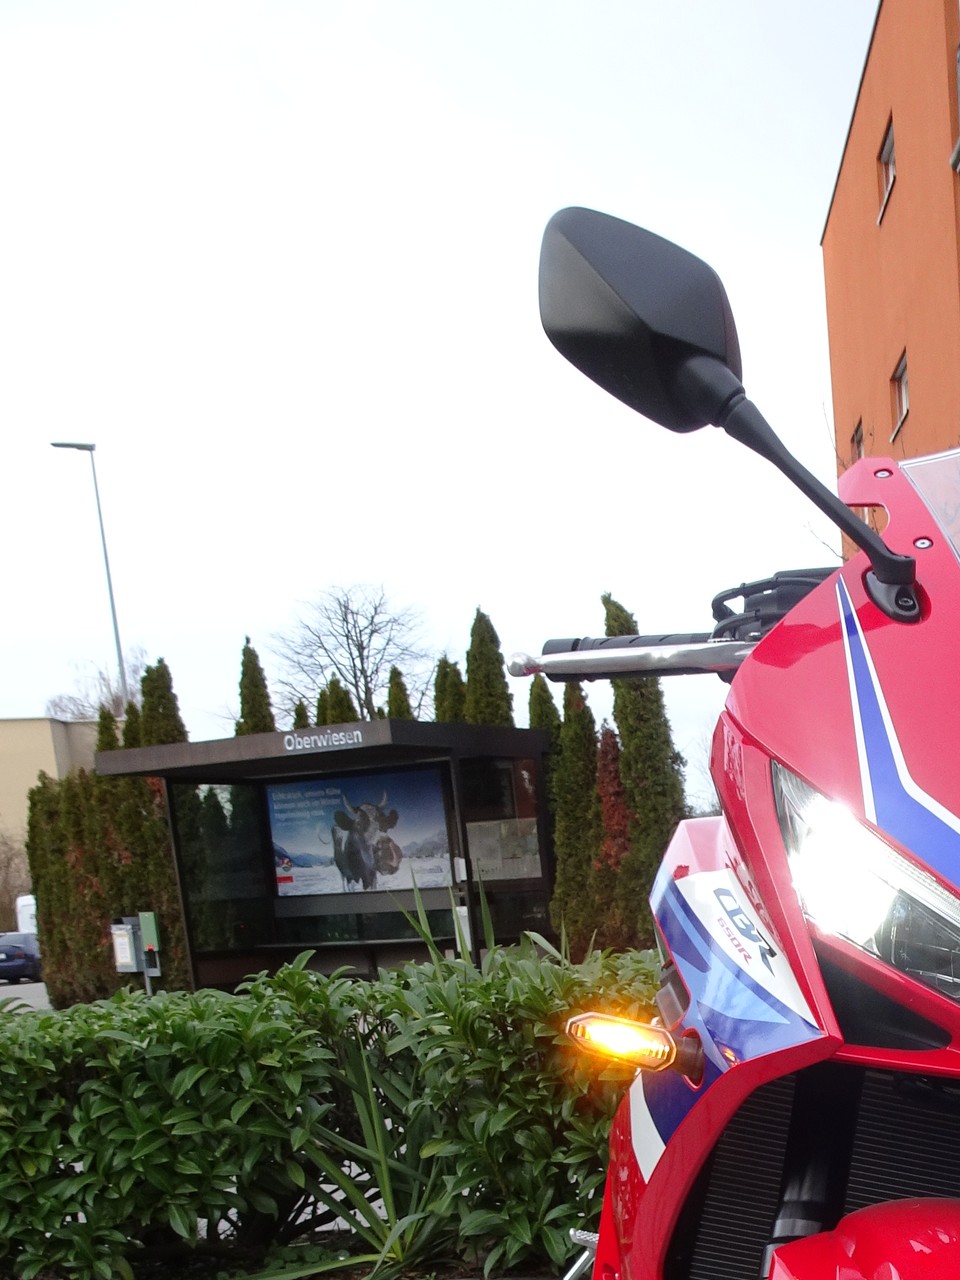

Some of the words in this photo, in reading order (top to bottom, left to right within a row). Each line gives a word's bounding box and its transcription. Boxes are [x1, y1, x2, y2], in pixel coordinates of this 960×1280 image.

[284, 730, 363, 751] Oberwiesen
[713, 888, 777, 977] CBR
[717, 916, 752, 966] 650R
